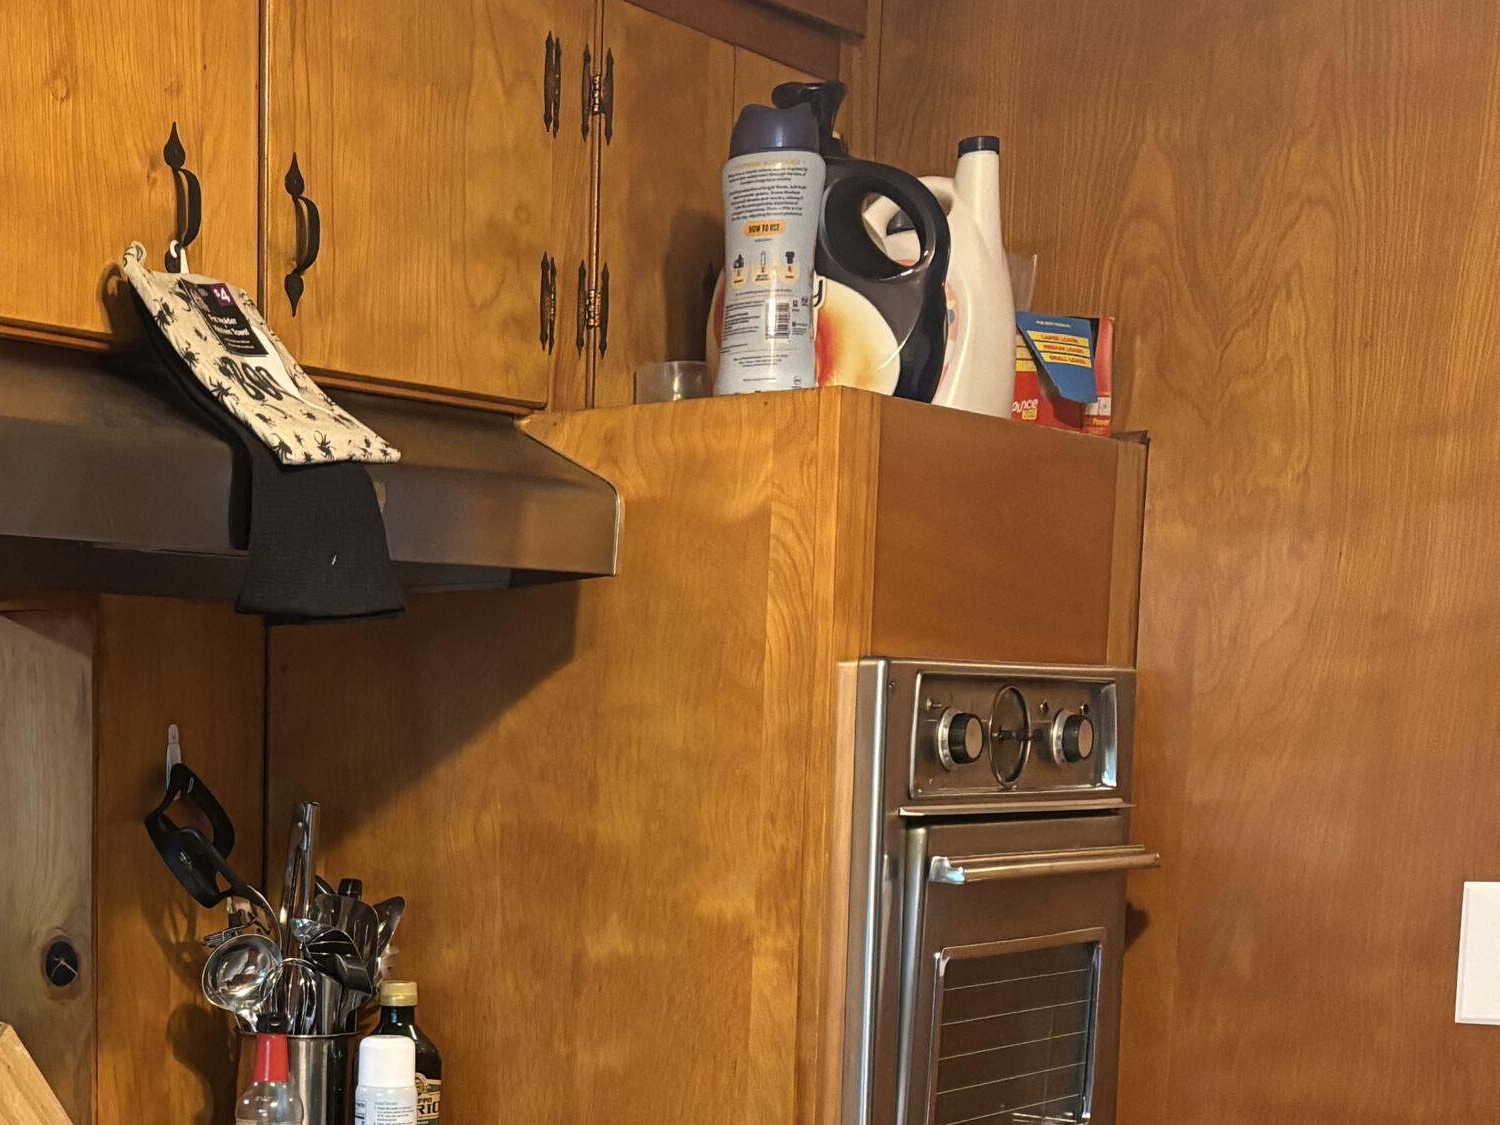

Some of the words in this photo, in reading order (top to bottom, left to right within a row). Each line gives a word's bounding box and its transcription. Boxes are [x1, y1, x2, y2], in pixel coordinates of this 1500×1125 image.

[761, 224, 769, 232] TO
[1012, 399, 1039, 413] ounce
[417, 1102, 440, 1115] RIO
